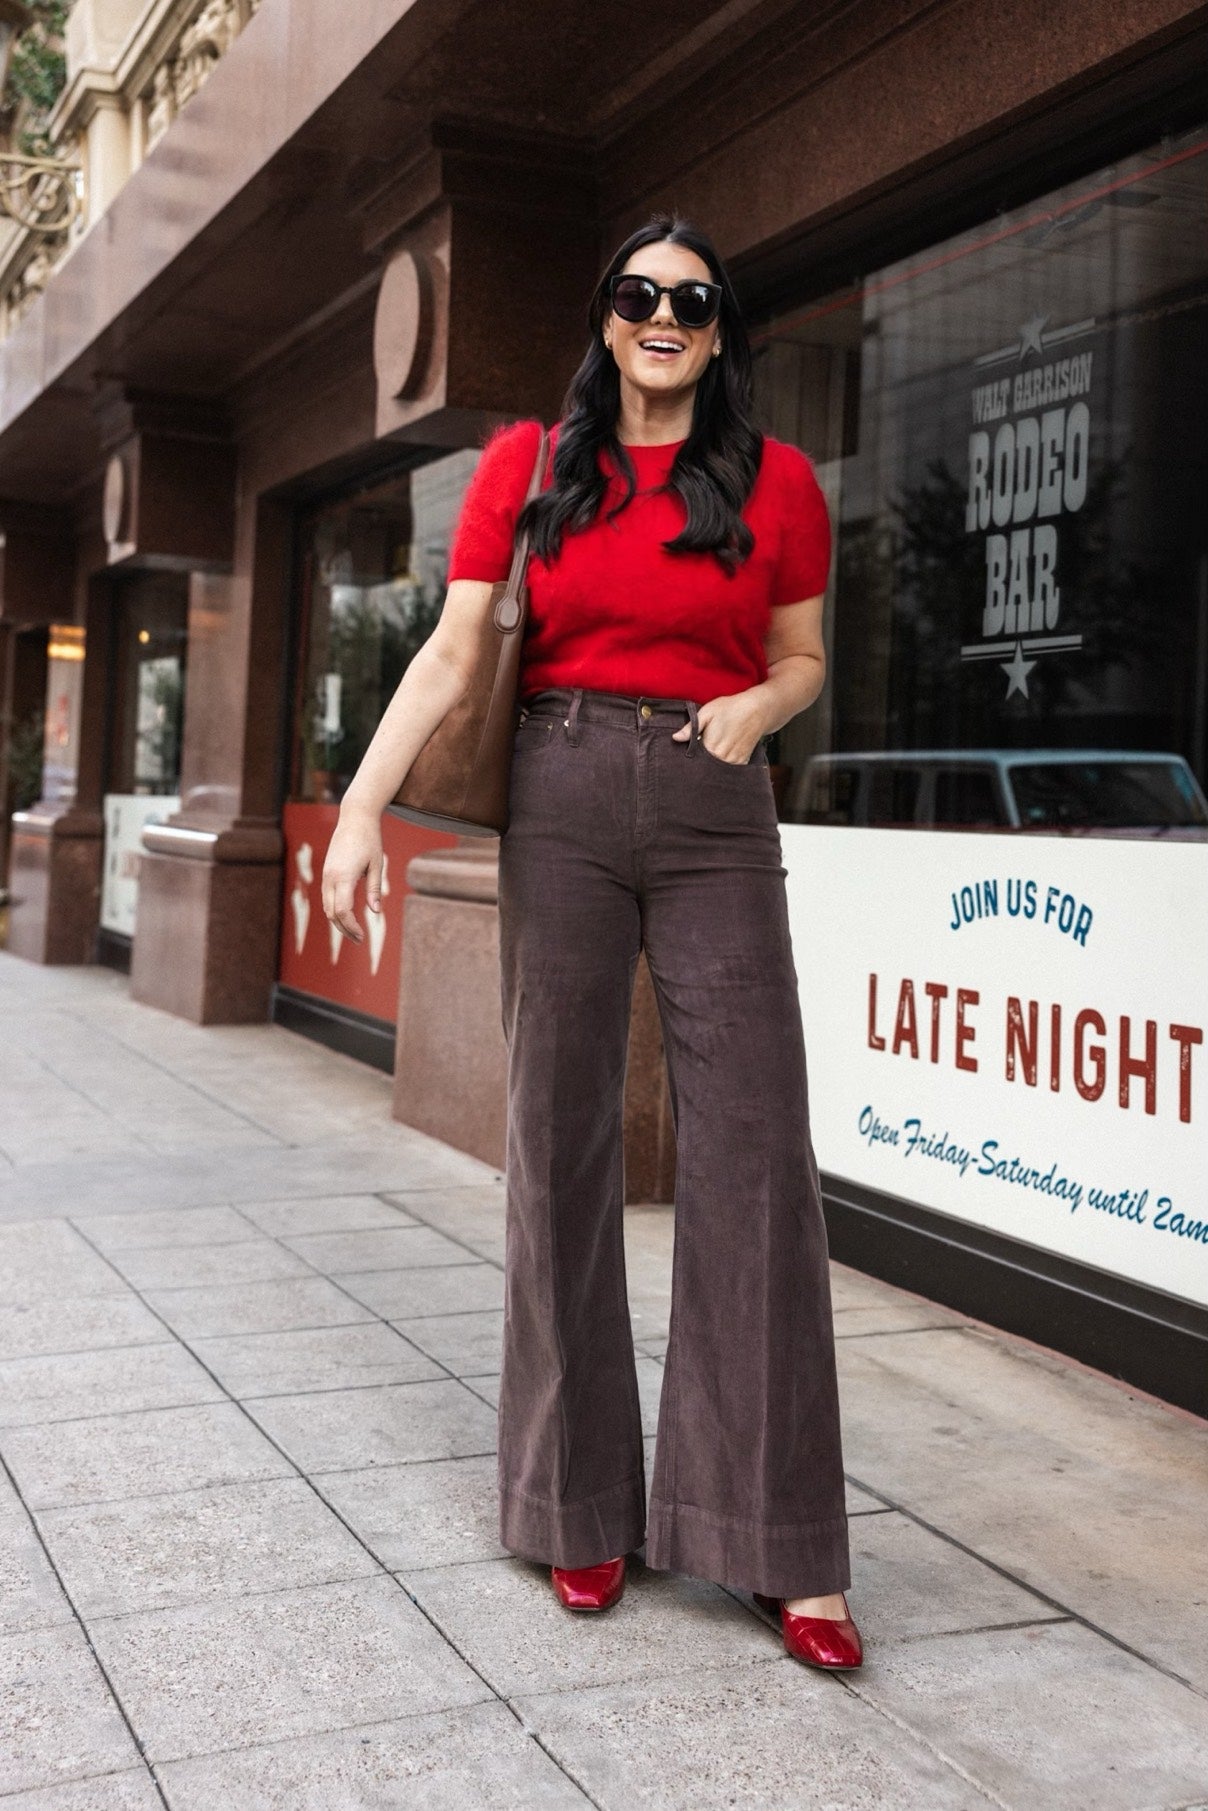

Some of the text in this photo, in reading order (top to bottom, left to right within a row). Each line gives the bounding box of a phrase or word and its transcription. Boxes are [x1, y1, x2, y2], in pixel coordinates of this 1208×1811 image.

[971, 352, 1094, 425] WALT GARRISON
[965, 401, 1090, 534] RODEO
[982, 524, 1060, 637] BAR
[950, 878, 1093, 948] JOIN US FOR
[867, 973, 1204, 1124] LATE NIGHT
[858, 1104, 1208, 1244] Open Friday-Saturday until 2am
